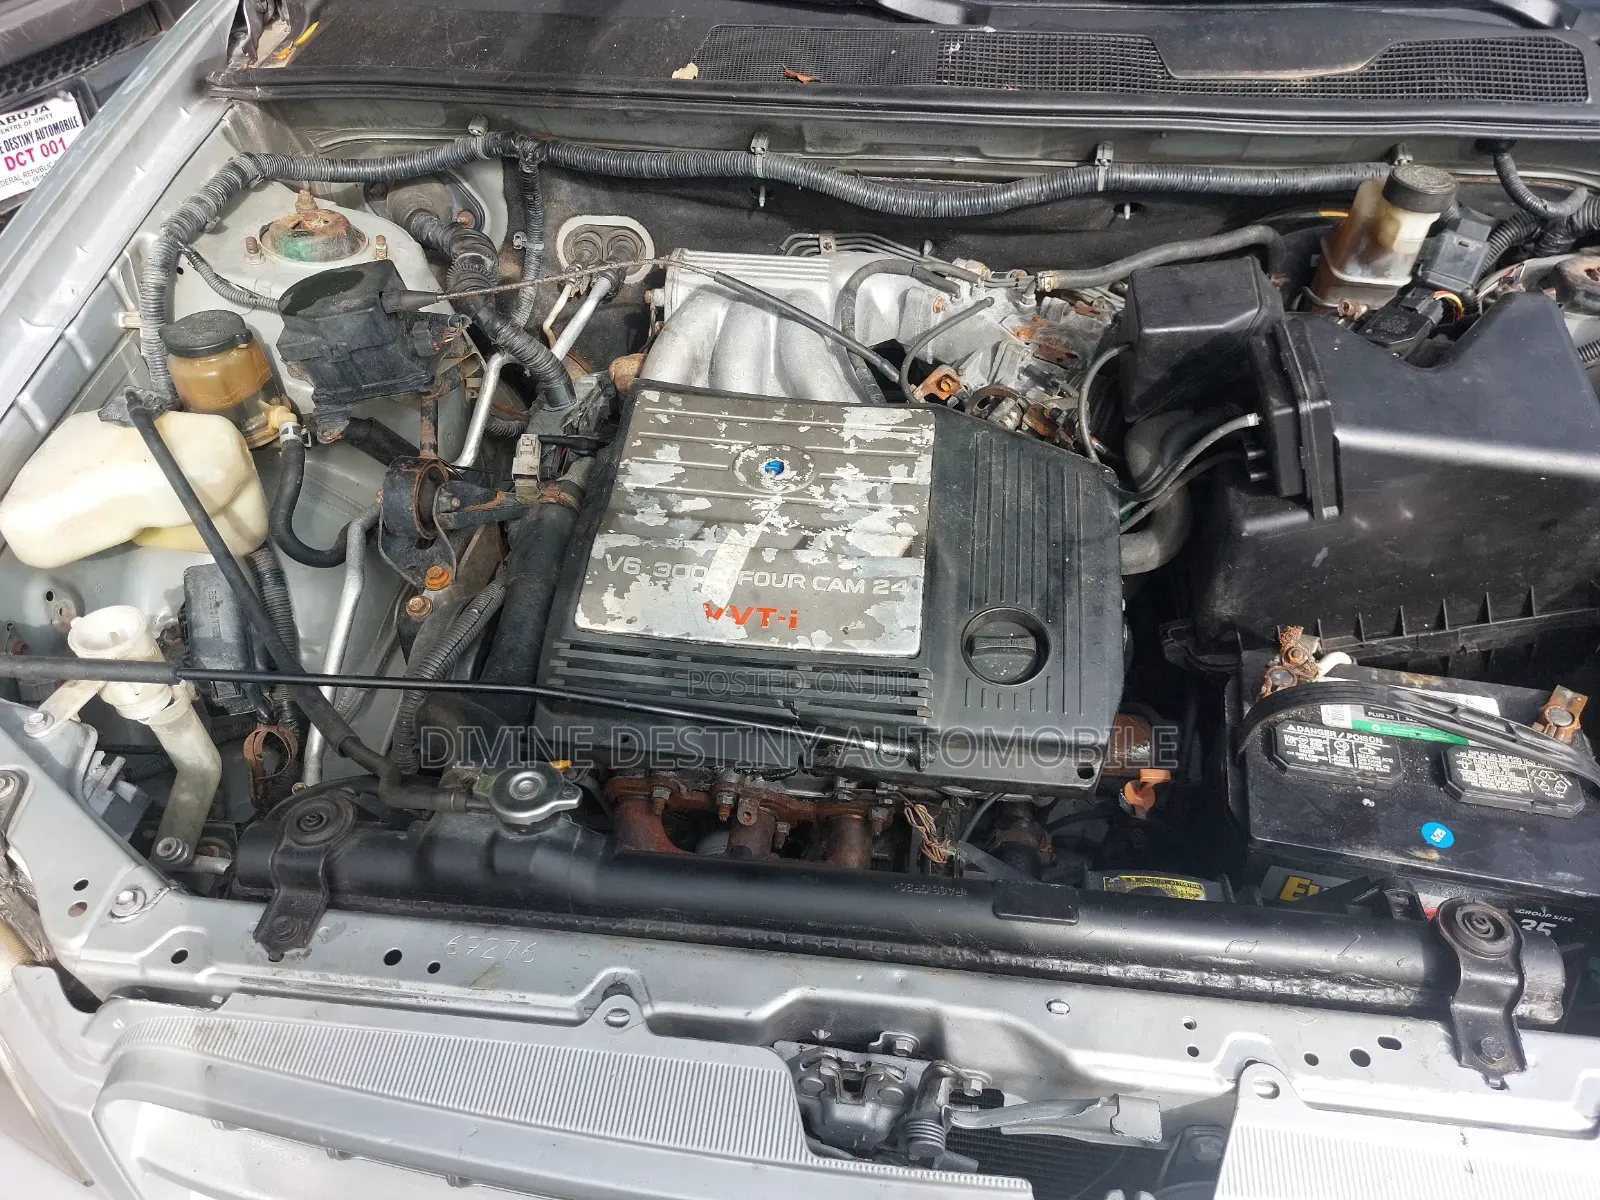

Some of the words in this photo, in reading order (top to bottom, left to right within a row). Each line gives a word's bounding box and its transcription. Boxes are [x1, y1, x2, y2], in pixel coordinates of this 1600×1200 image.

[3, 131, 34, 152] DESTINY
[35, 115, 80, 141] AUTOMOBILE
[23, 118, 32, 127] OF
[34, 112, 54, 124] UNITY
[4, 147, 35, 171] DCT
[40, 137, 67, 158] 001
[605, 553, 642, 575] V6
[737, 570, 806, 590] FOUR
[812, 576, 865, 595] CAM
[703, 601, 798, 631] VVT-i
[1296, 725, 1337, 738] DANGER
[1346, 732, 1383, 745] POISON
[1518, 908, 1552, 918] GROUP
[1552, 915, 1575, 923] SIZE
[445, 934, 538, 963] 69276
